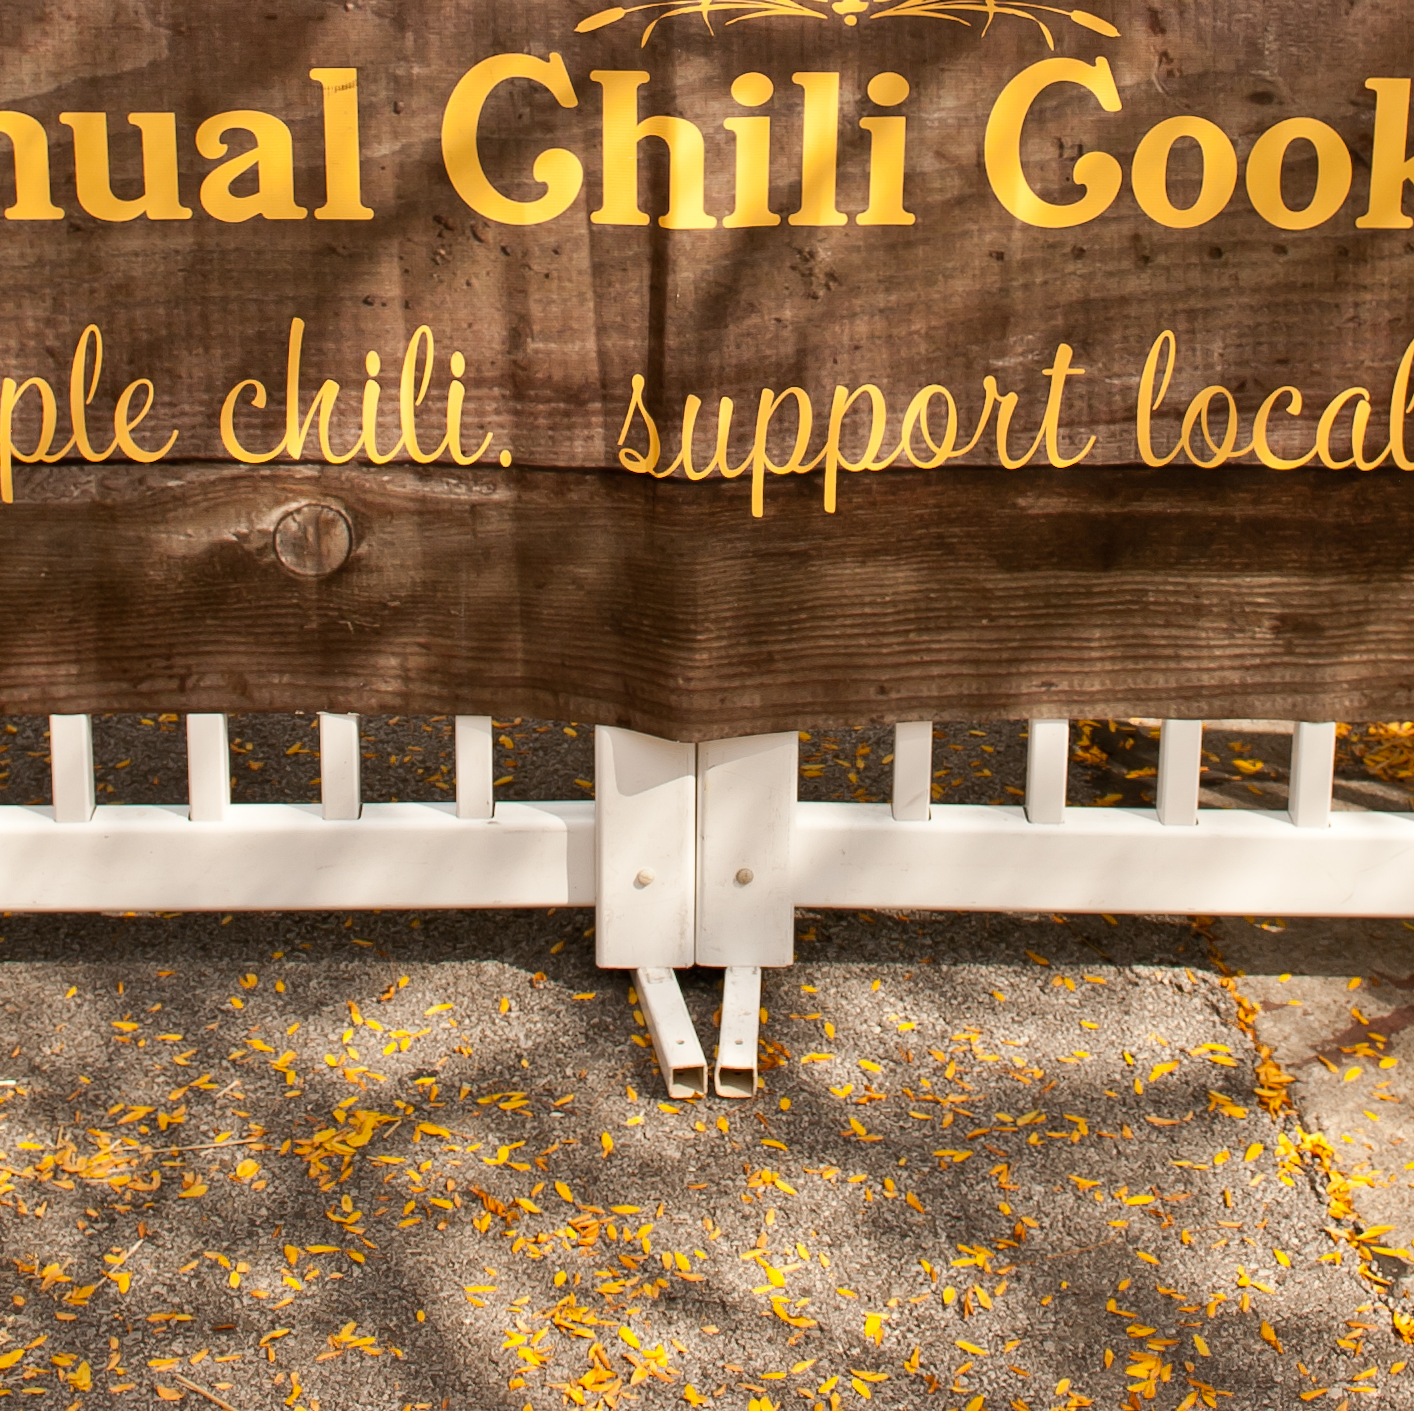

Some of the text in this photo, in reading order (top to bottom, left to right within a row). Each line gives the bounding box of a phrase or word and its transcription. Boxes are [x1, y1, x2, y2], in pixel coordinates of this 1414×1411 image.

[440, 51, 916, 230] Chili
[219, 317, 512, 468] chili.
[617, 343, 1097, 518] support
